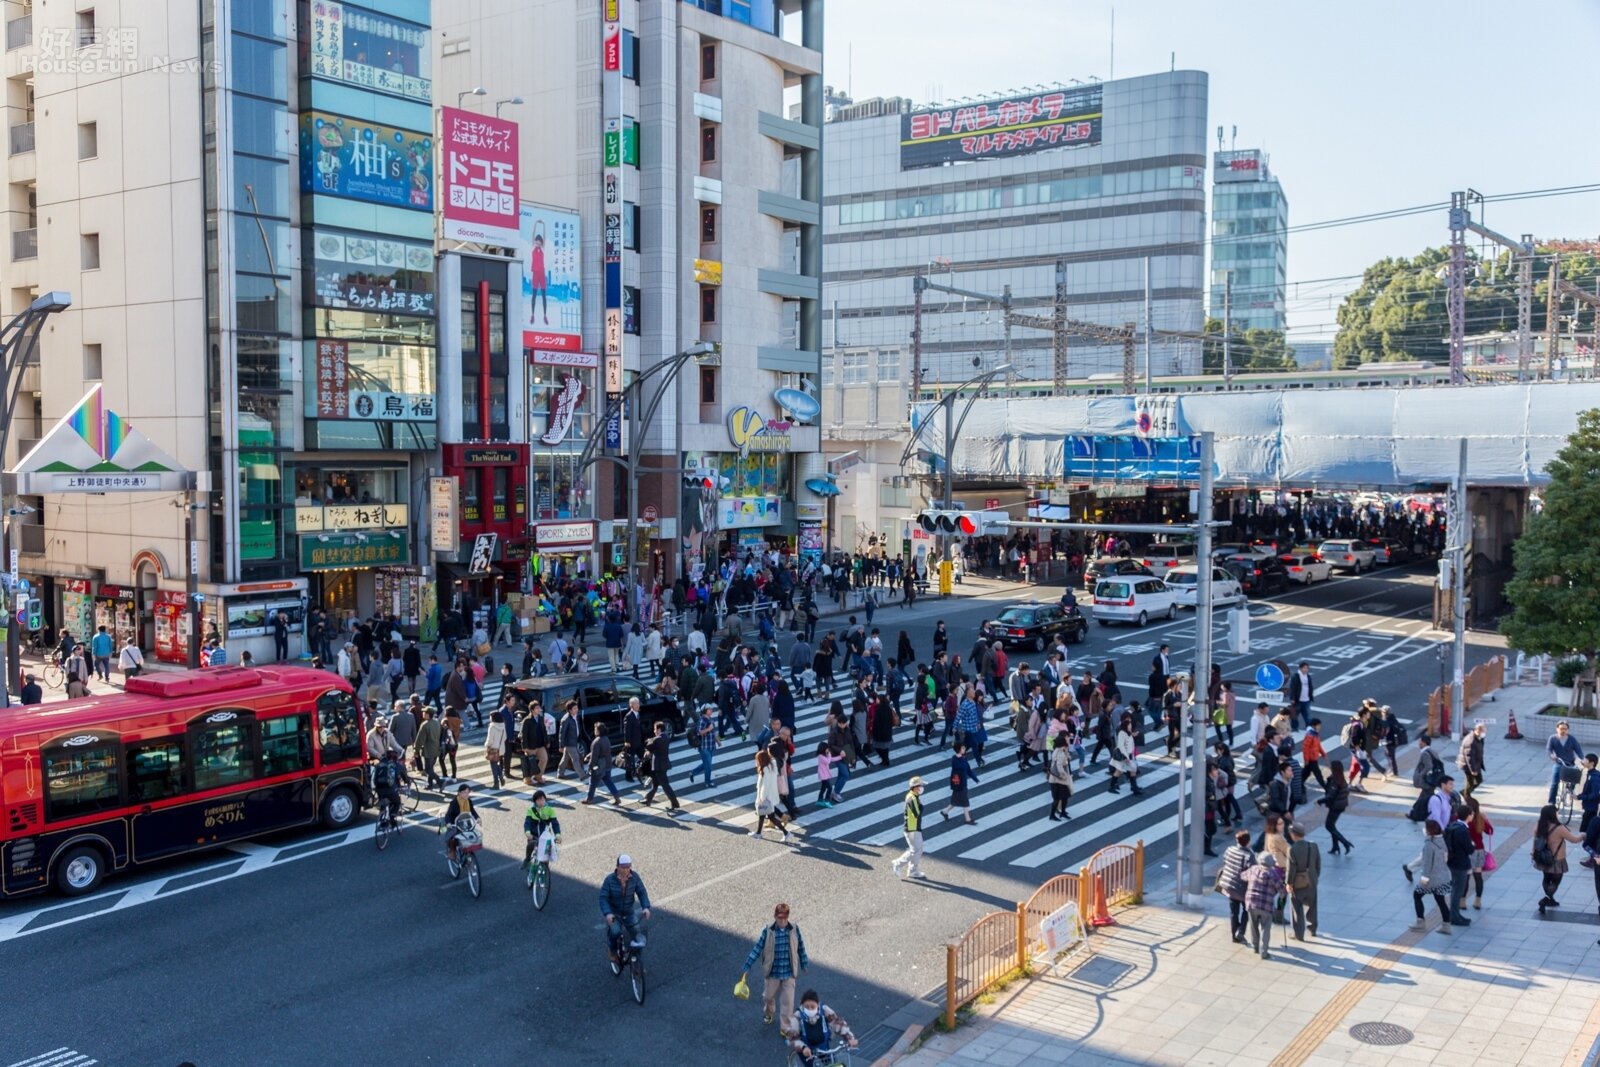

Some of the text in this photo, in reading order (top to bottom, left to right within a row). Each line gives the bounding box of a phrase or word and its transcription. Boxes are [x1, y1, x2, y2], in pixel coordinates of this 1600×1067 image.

[911, 93, 1066, 139] ヨドバシカメラ
[453, 118, 512, 140] ドコモグループ
[960, 122, 1092, 154] マルチメディア上野
[452, 131, 511, 153] 公式求人サイト
[608, 136, 617, 163] レイク
[449, 150, 515, 193] ドコモ
[452, 189, 511, 211] 求人ナビ
[457, 228, 485, 239] docomo
[541, 352, 592, 364] スポーツジュエン
[382, 396, 433, 417] 鳥福
[67, 477, 147, 487] 上野御徒町中央通り
[299, 514, 320, 523] 牛たん
[354, 507, 397, 525] ねぎし
[539, 527, 591, 539] SPORTS ZYUEN
[119, 588, 134, 599] zero
[204, 811, 246, 828] めぐりん
